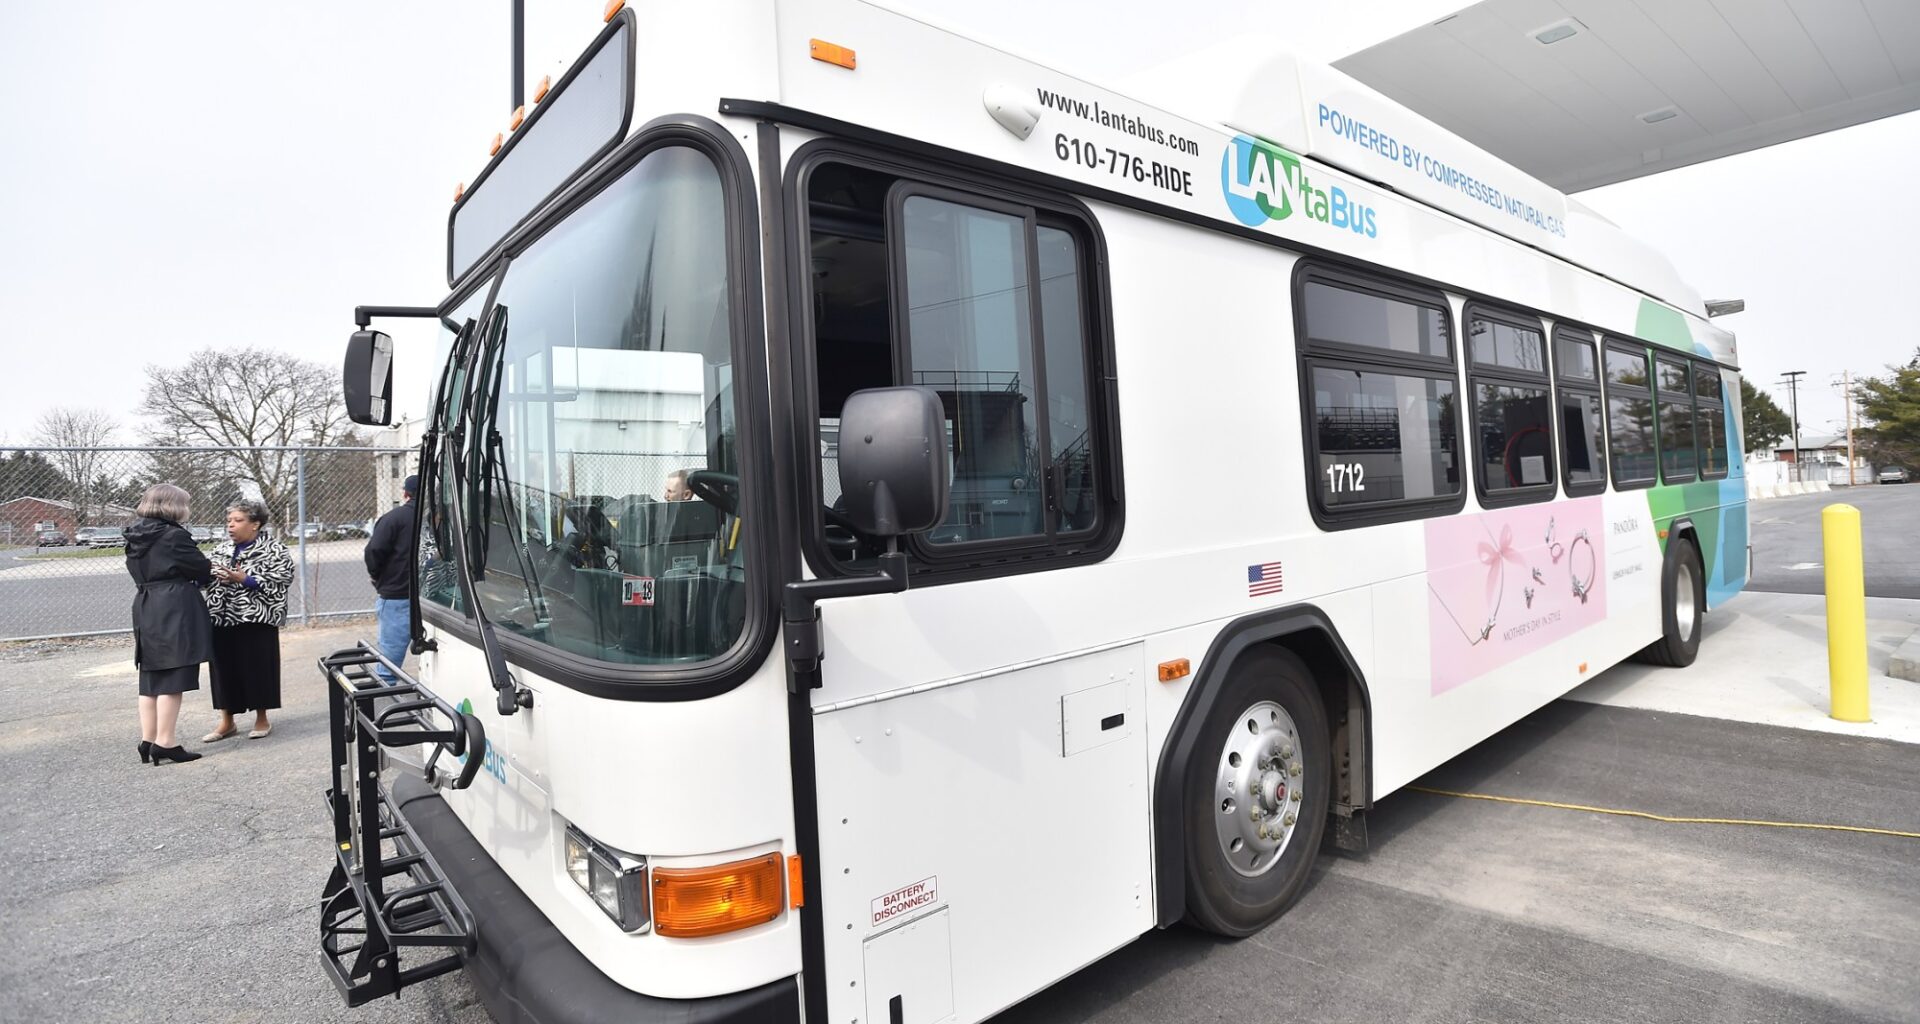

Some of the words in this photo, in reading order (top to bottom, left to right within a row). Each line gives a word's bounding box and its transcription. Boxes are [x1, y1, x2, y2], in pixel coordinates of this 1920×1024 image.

[1037, 88, 1199, 157] www.lantabus.com
[1055, 133, 1193, 196] 610-776-RIDE
[1319, 103, 1399, 161] POWERED
[1403, 145, 1421, 171] BY
[1423, 156, 1503, 210] COMPRESSED
[1503, 194, 1548, 231] NATURAL
[1227, 142, 1377, 239] LANtaBus
[1326, 463, 1365, 493] 1712
[624, 582, 633, 601] 10
[643, 581, 653, 600] 18
[874, 890, 935, 922] DISCONNECT
[883, 882, 926, 907] BATTERY
